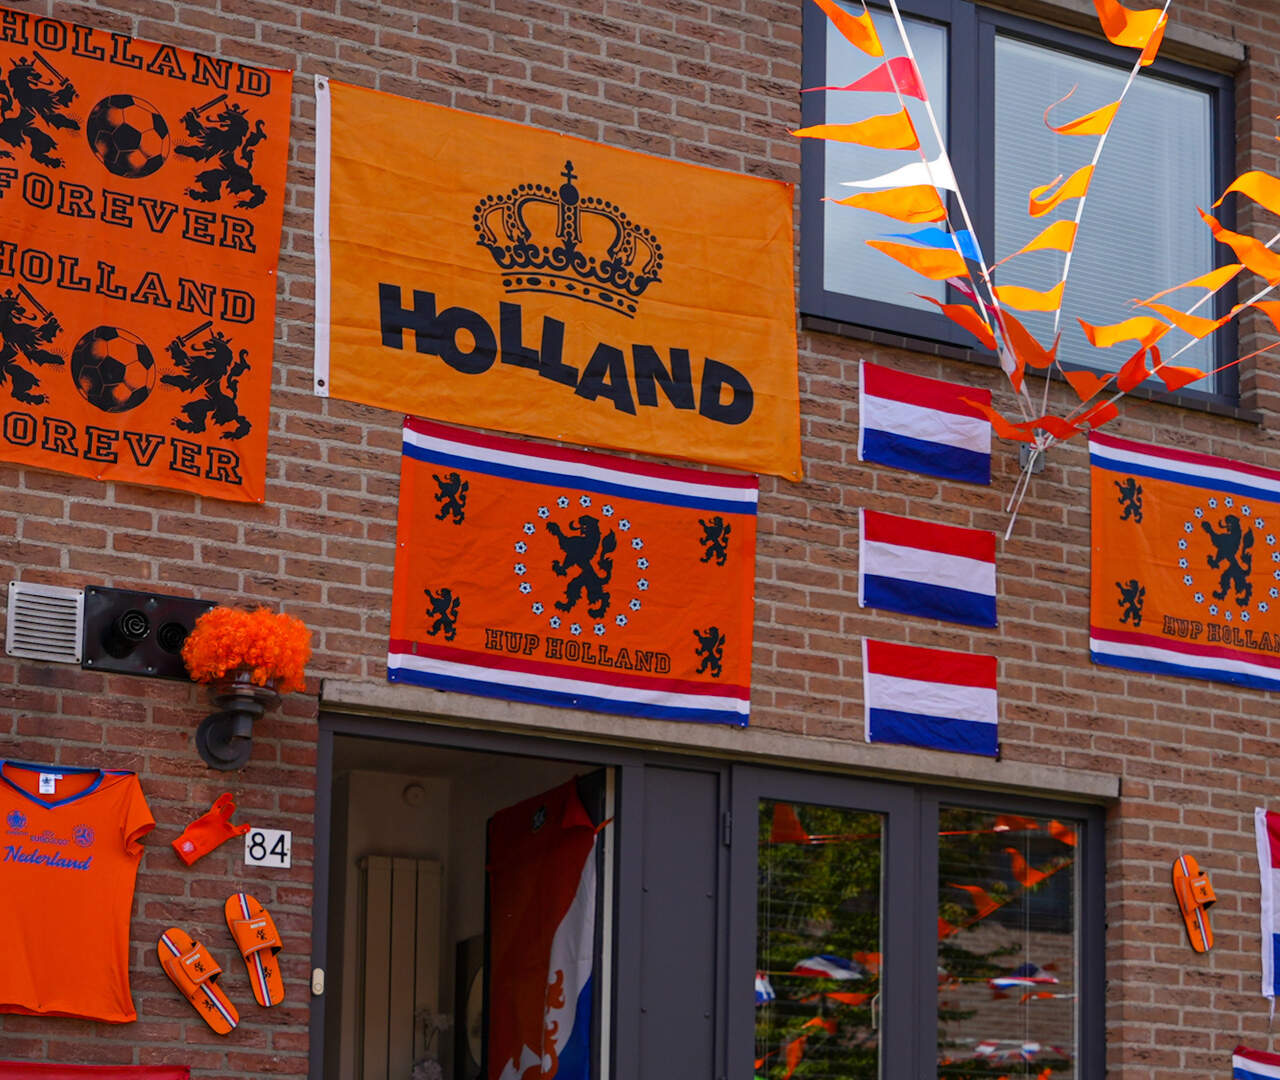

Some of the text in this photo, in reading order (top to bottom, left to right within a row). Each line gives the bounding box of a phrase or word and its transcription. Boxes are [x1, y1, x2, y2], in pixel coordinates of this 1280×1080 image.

[378, 282, 755, 426] HOLLAND
[1162, 615, 1203, 641] HUP
[485, 629, 671, 674] HUP HOLLAND
[3, 845, 93, 871] Nederland
[249, 831, 288, 864] 84
